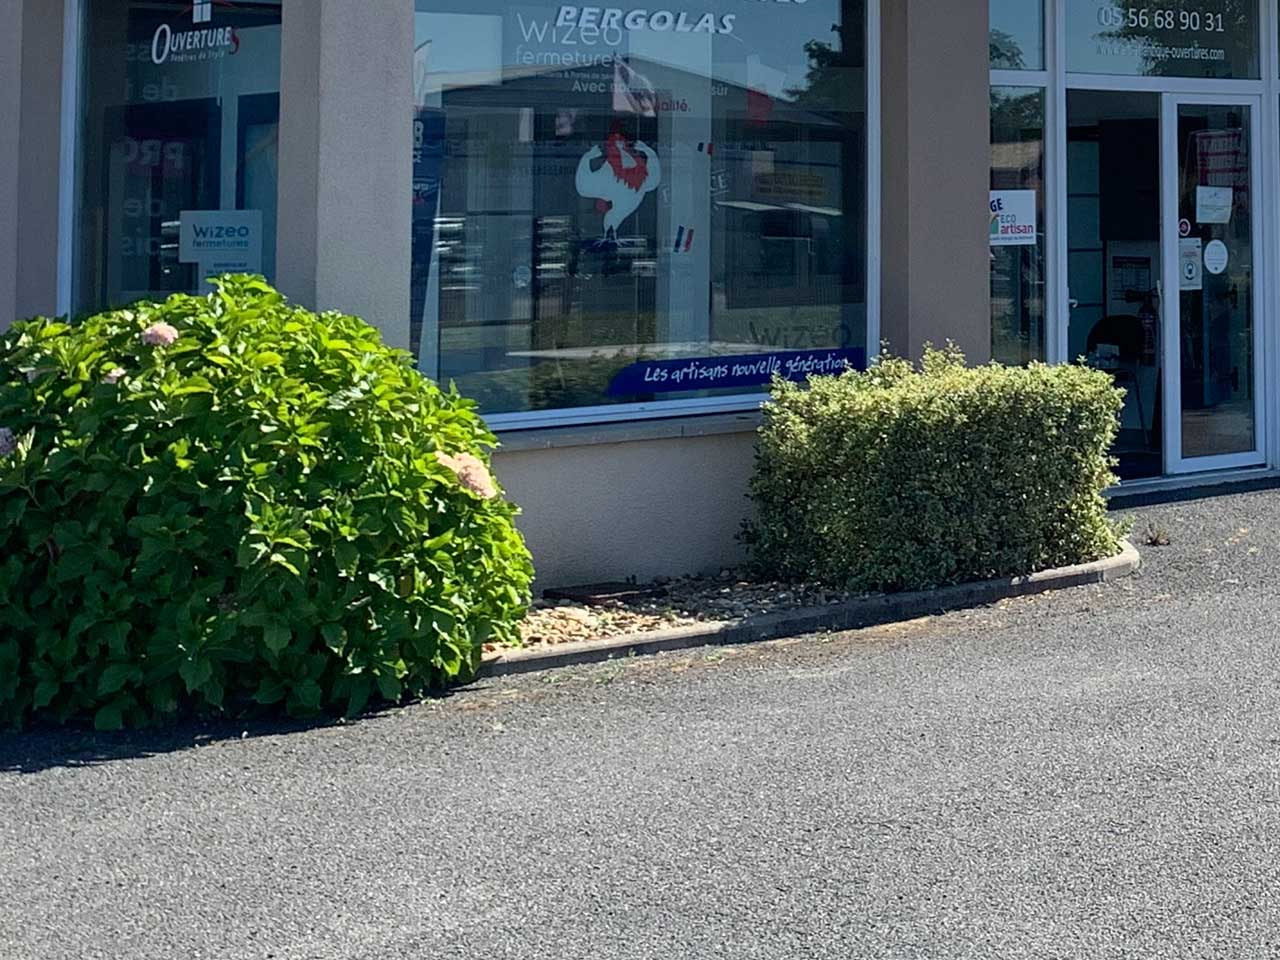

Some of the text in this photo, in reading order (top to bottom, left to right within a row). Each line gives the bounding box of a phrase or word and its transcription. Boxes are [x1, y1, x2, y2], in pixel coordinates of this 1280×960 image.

[556, 6, 737, 35] PERGOLAS
[1128, 8, 1149, 28] 56
[1154, 10, 1175, 29] 68
[1179, 11, 1200, 31] 90
[1205, 12, 1225, 32] 31
[152, 24, 241, 65] OUVERTURES
[571, 81, 606, 94] Avec
[1000, 214, 1017, 224] ECO
[1000, 223, 1034, 235] artisan
[645, 367, 667, 382] Les
[671, 362, 728, 383] artisans
[732, 356, 781, 376] nouvelle
